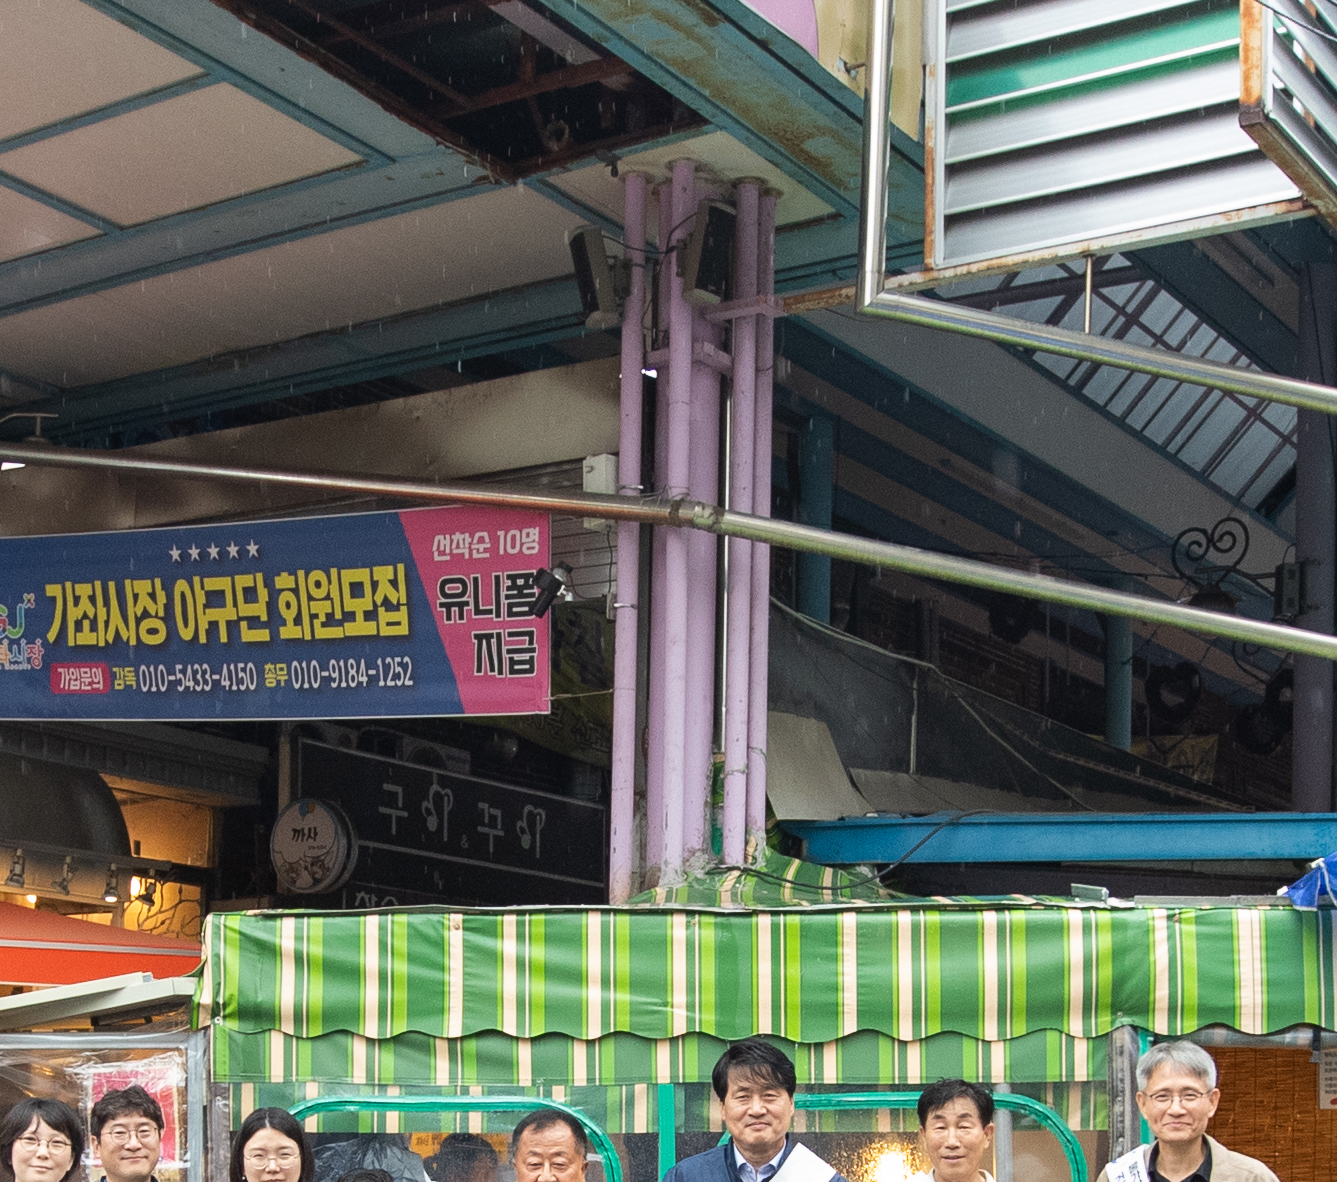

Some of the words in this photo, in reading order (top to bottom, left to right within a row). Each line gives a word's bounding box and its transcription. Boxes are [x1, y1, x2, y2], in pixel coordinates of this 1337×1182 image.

[432, 530, 491, 561] 선착순
[496, 526, 541, 556] 10명
[44, 577, 167, 648] 가좌시장
[173, 571, 270, 645] 야구단
[274, 562, 410, 642] 회원모집
[436, 569, 538, 625] 유니폼
[56, 667, 104, 691] 가입문의
[112, 666, 137, 690] 감독
[139, 662, 257, 693] 010-5433-4150
[290, 657, 415, 690] 010-9184-1252
[471, 628, 539, 679] 지급
